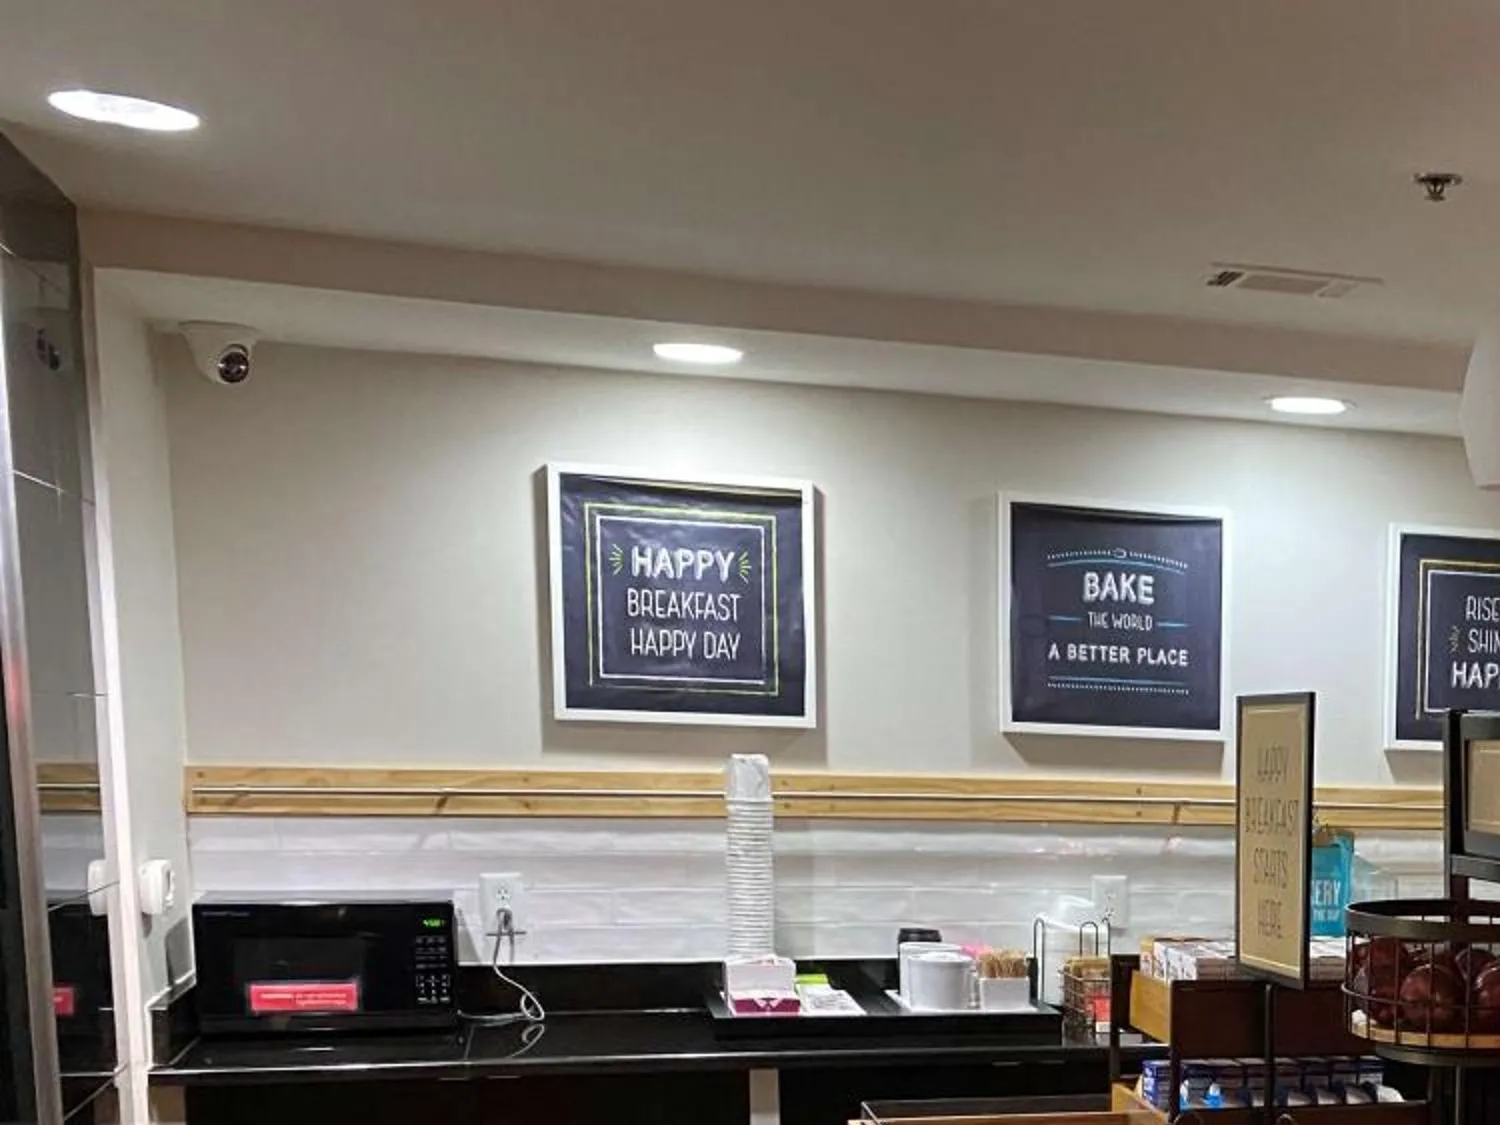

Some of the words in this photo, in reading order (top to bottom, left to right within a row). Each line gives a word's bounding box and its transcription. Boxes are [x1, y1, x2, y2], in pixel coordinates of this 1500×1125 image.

[631, 545, 736, 582] HAPPY
[1082, 571, 1155, 605] BAKE
[626, 588, 741, 622] BREAKFAST
[1465, 595, 1500, 623] RISE
[1088, 611, 1109, 630] THE
[1112, 612, 1154, 632] WORLD
[630, 627, 697, 658] HAPPY
[703, 631, 741, 661] DAY
[1048, 643, 1060, 661] A
[1067, 643, 1131, 665] BETTER
[1137, 647, 1189, 666] PLACE
[1311, 879, 1342, 905] ERY
